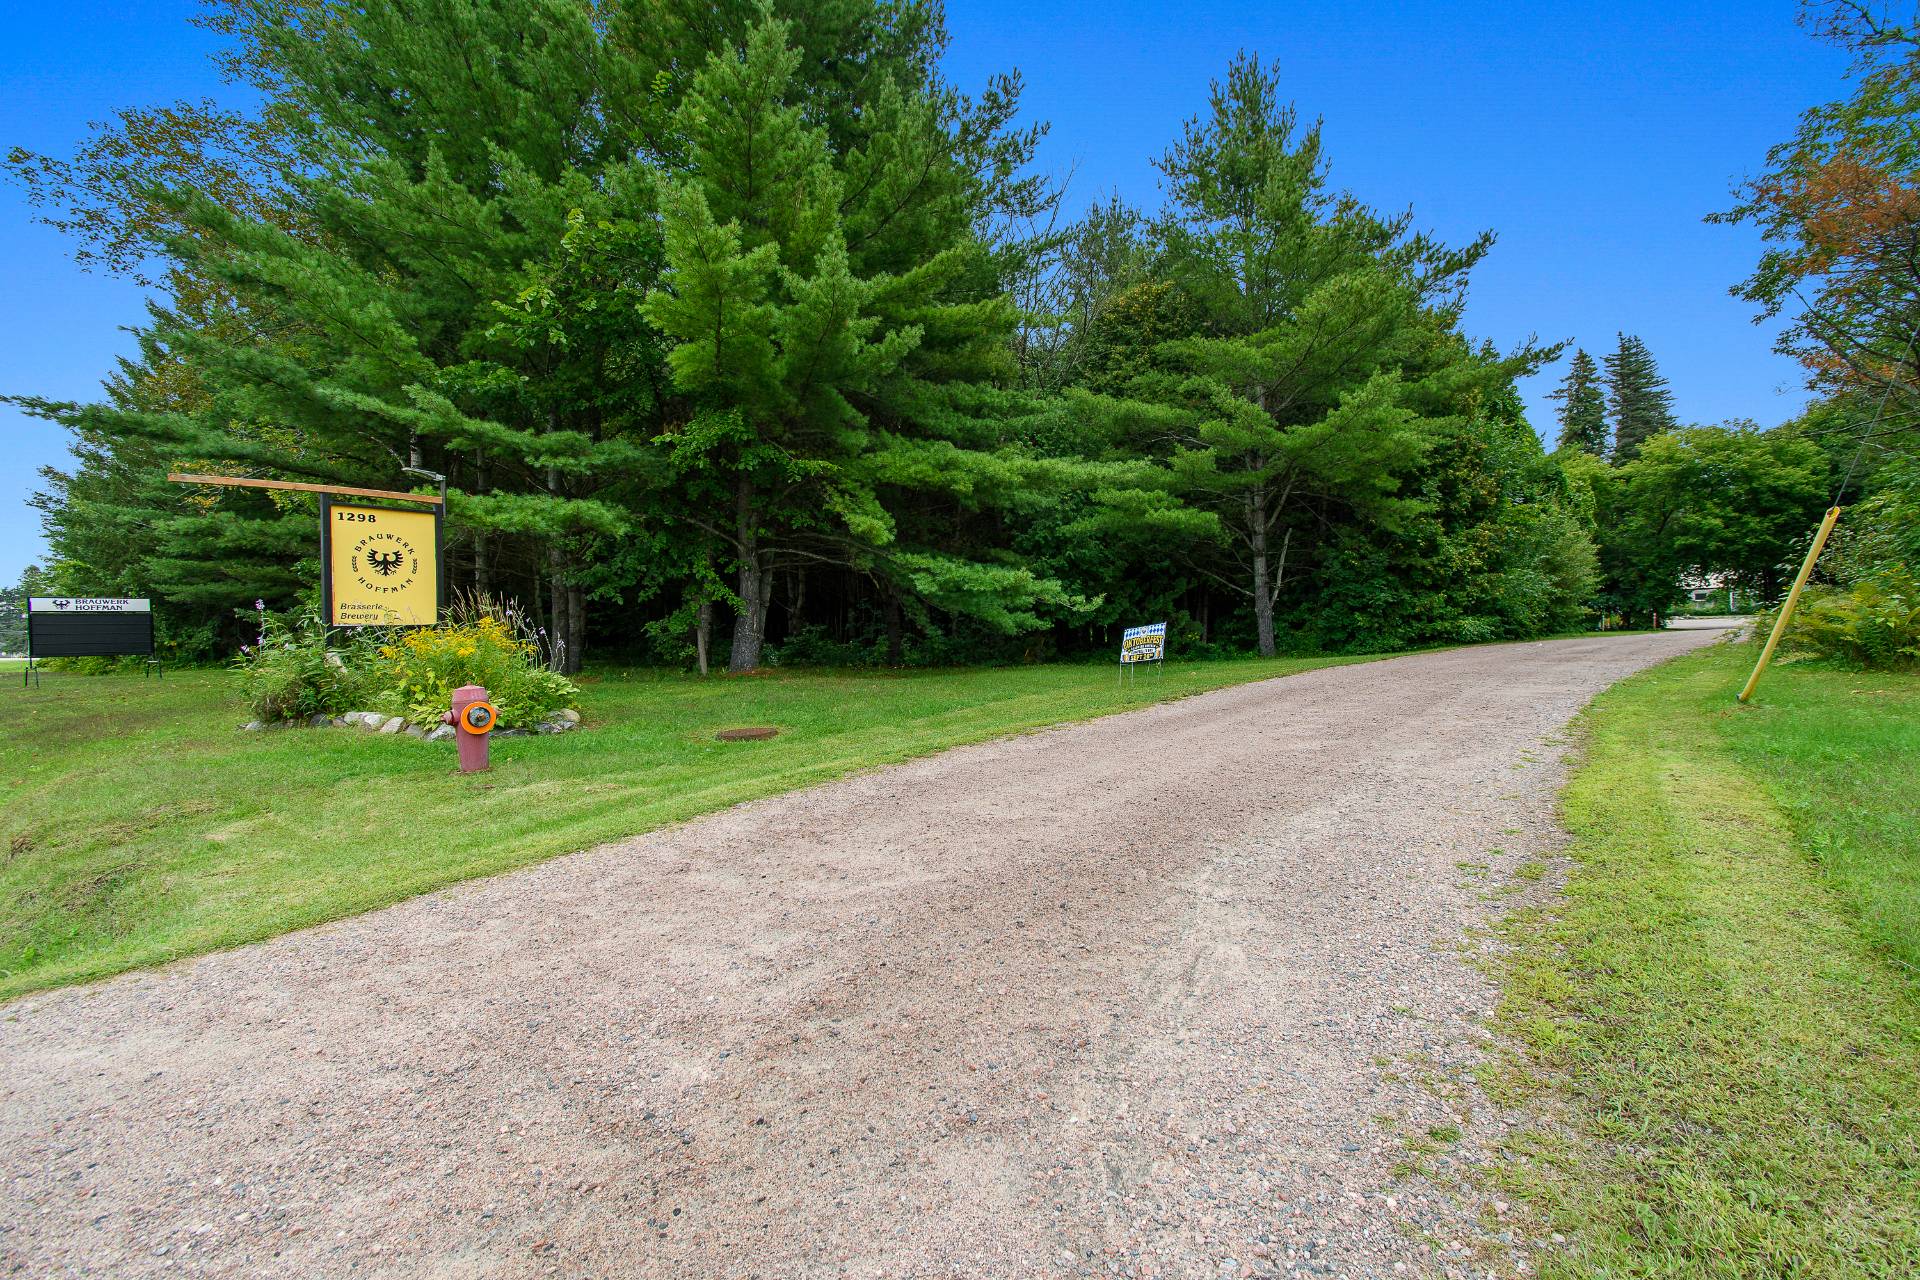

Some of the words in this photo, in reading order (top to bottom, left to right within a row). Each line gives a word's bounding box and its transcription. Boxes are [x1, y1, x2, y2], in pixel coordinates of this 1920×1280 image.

[337, 512, 377, 523] 1298
[354, 533, 415, 555] BRAUWERK
[357, 576, 414, 594] HOFFMAN
[340, 602, 384, 610] Brasserie
[340, 612, 379, 621] Brewery
[1123, 635, 1163, 650] OKTOBERFEST
